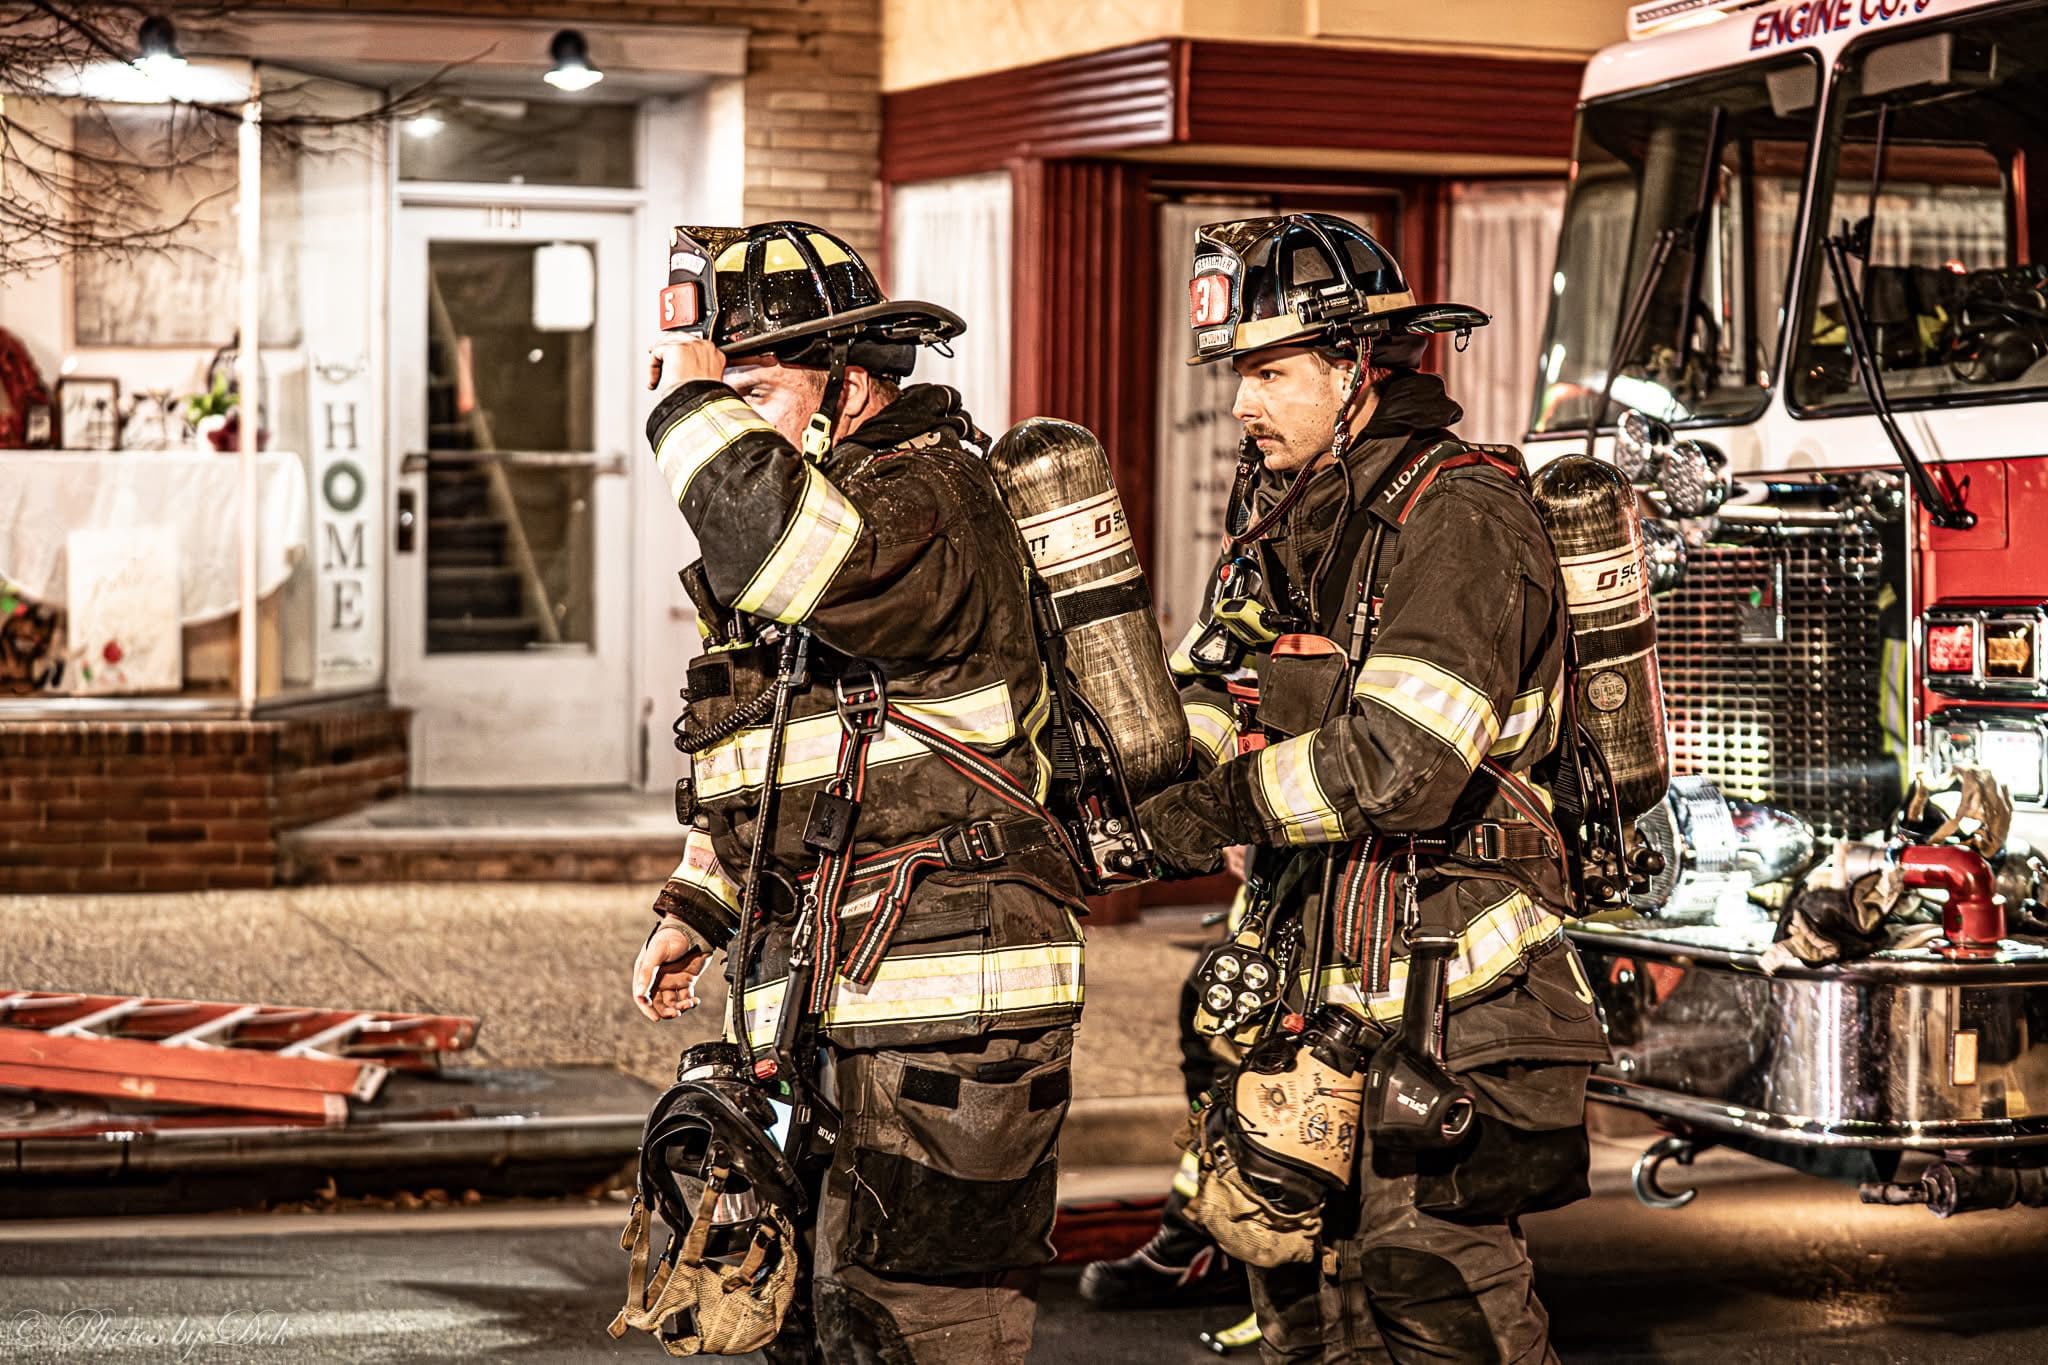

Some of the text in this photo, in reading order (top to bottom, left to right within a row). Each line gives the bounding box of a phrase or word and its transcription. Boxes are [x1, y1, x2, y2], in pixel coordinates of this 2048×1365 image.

[1750, 0, 1852, 51] ENGINE
[664, 291, 675, 322] 5
[1196, 279, 1211, 323] 3
[322, 402, 366, 630] HOME
[1028, 534, 1050, 552] TT
